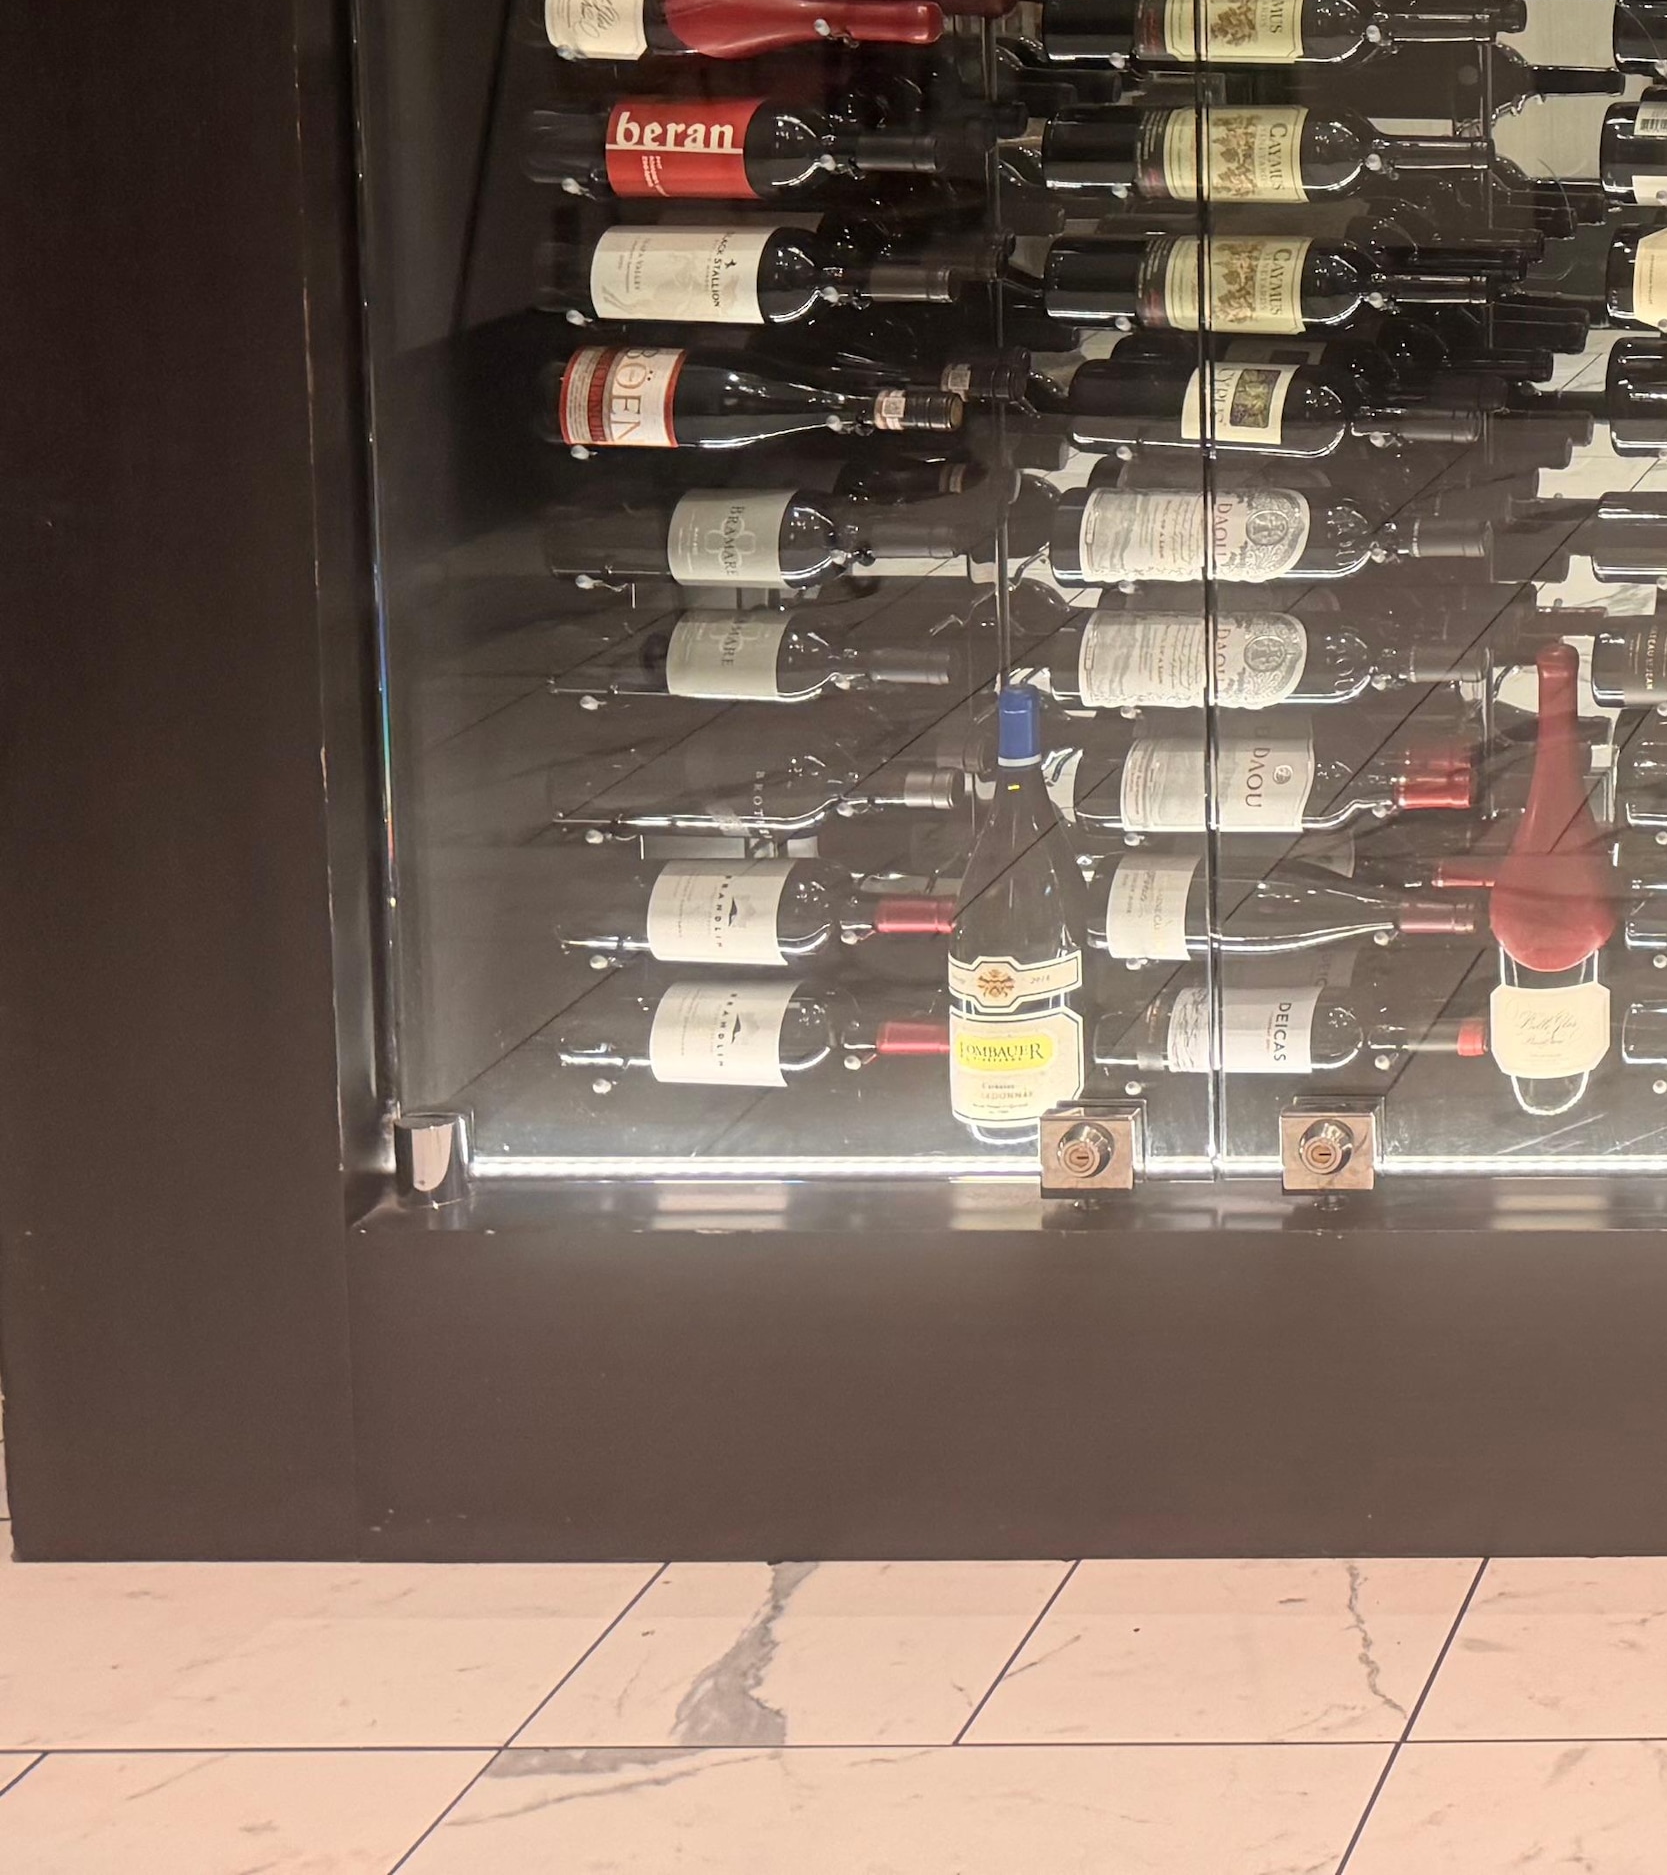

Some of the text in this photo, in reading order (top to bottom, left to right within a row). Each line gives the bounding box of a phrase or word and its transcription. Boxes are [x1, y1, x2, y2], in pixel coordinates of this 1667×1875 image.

[615, 111, 734, 149] beran
[1268, 123, 1289, 191] CAYMUS
[710, 257, 722, 307] STALLION
[1268, 248, 1290, 315] CAYMUS
[722, 506, 745, 576] BRAMARE
[1214, 503, 1234, 557] DAOU
[1213, 629, 1232, 682] DAOU
[1645, 667, 1654, 689] JEAN
[1246, 748, 1269, 807] DAOU
[1272, 1002, 1292, 1062] DEICAS
